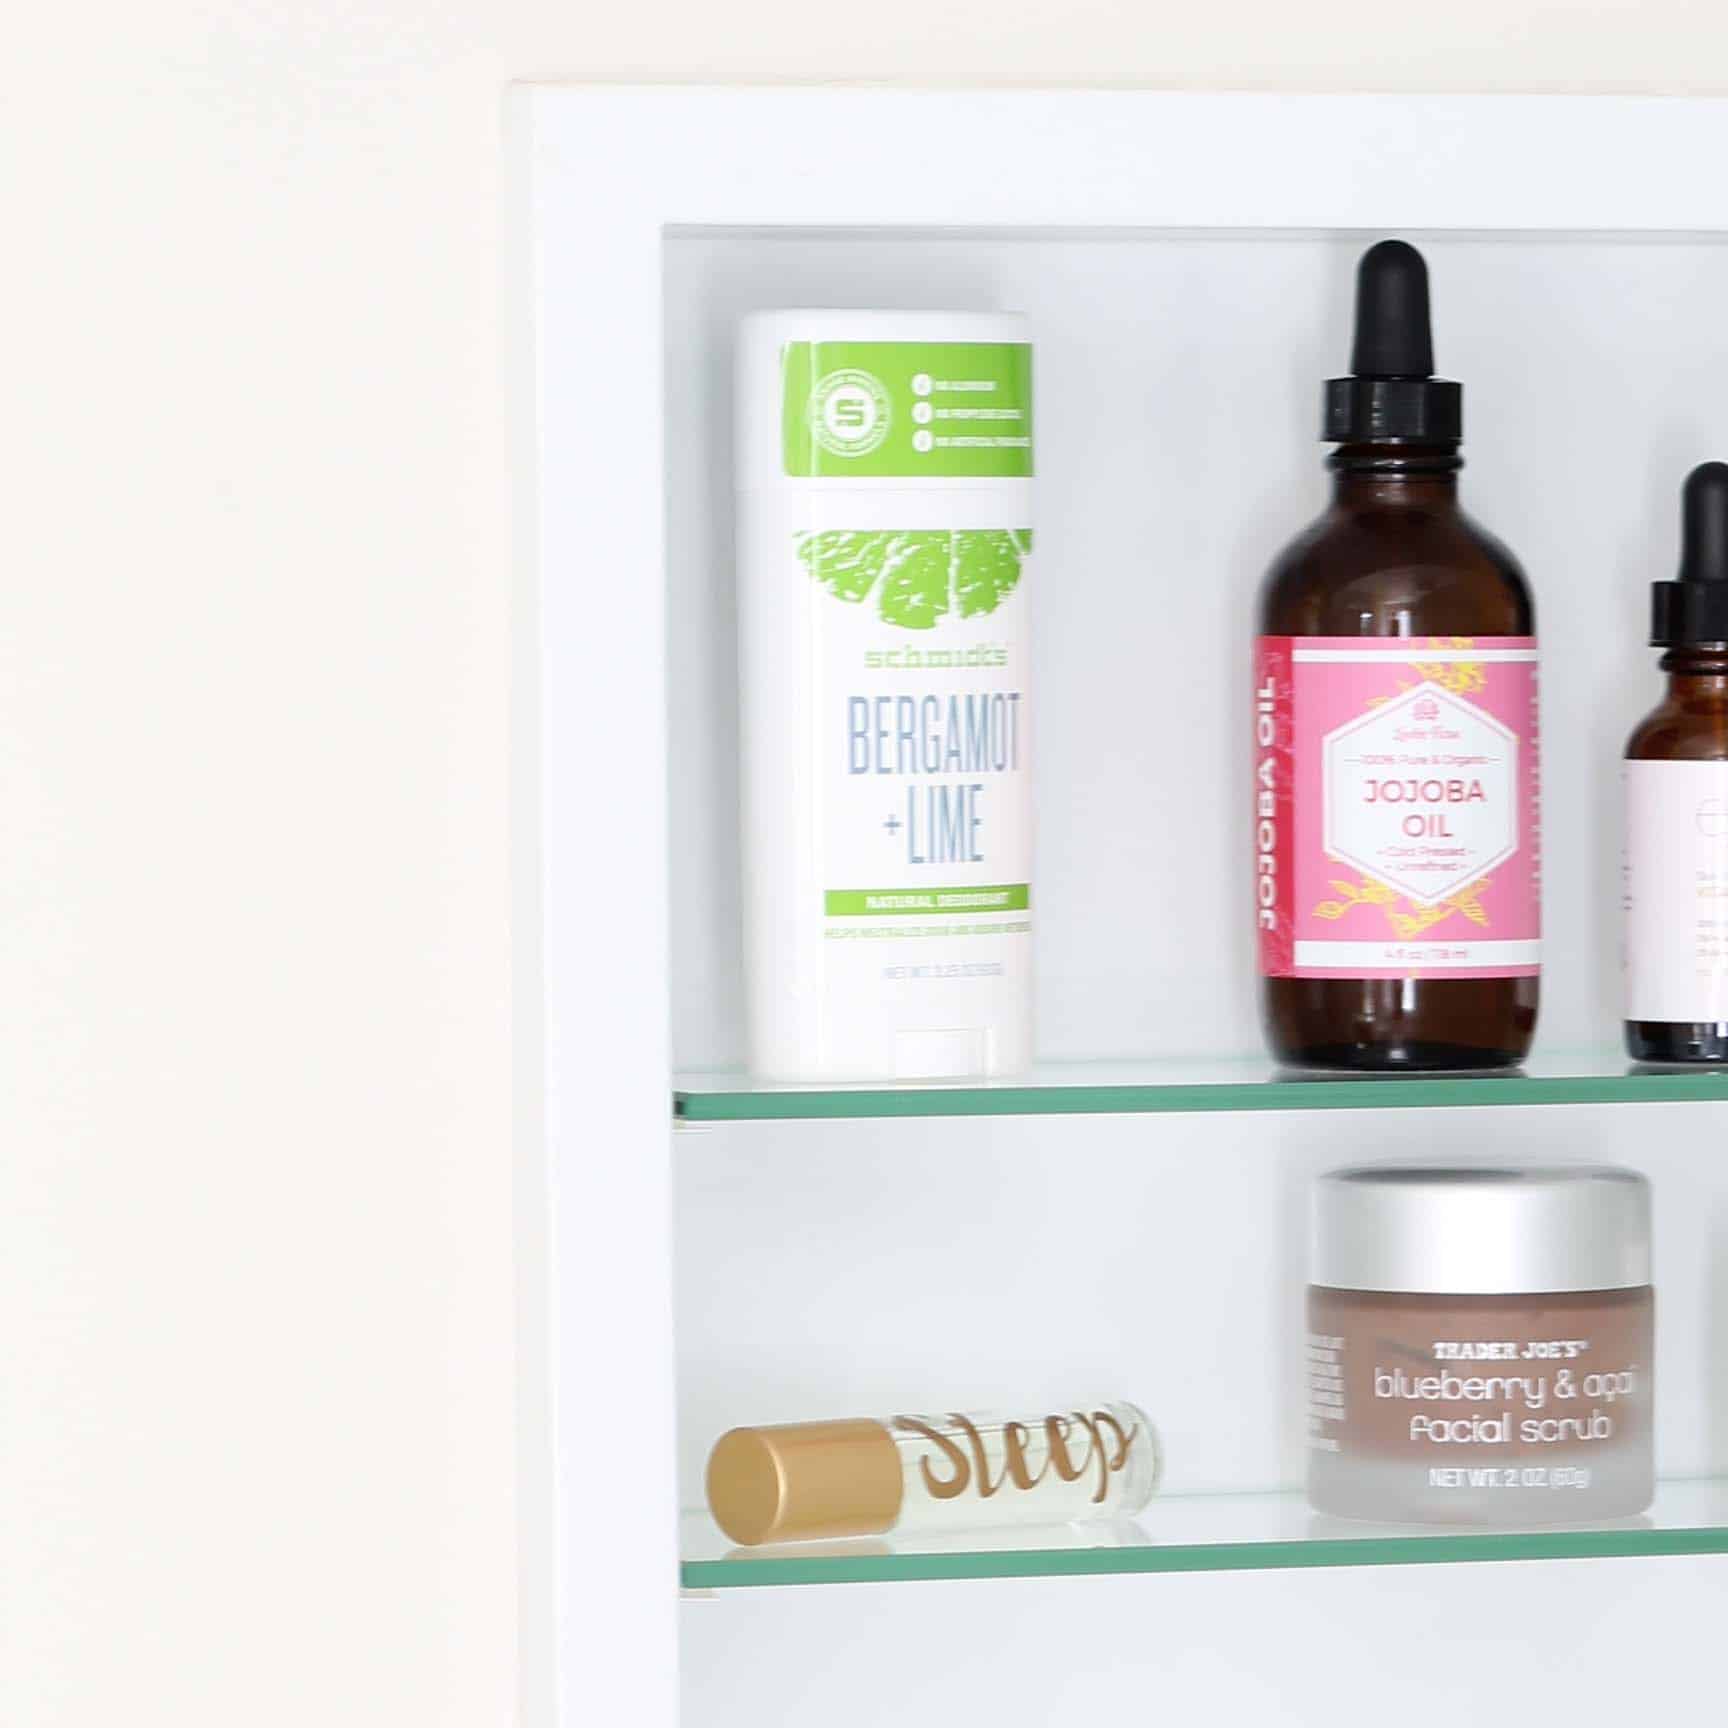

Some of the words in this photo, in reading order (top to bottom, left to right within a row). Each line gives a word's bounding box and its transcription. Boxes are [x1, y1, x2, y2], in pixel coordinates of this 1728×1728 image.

[1257, 676, 1277, 748] OIL
[846, 692, 1023, 776] BERGAMOT
[1363, 779, 1487, 803] JOJOBA
[907, 783, 985, 865] LIME
[1257, 756, 1279, 932] JOJOBA
[1401, 813, 1455, 838] OIL
[1431, 1340, 1520, 1361] TRADER
[1521, 1340, 1584, 1360] JOE'S
[1374, 1366, 1547, 1409] blueberry
[1553, 1368, 1578, 1399] &
[1409, 1412, 1513, 1443] facial
[1519, 1408, 1613, 1441] scrub
[892, 1411, 1138, 1504] Sleep
[1429, 1467, 1466, 1488] NET
[1503, 1468, 1520, 1488] 2
